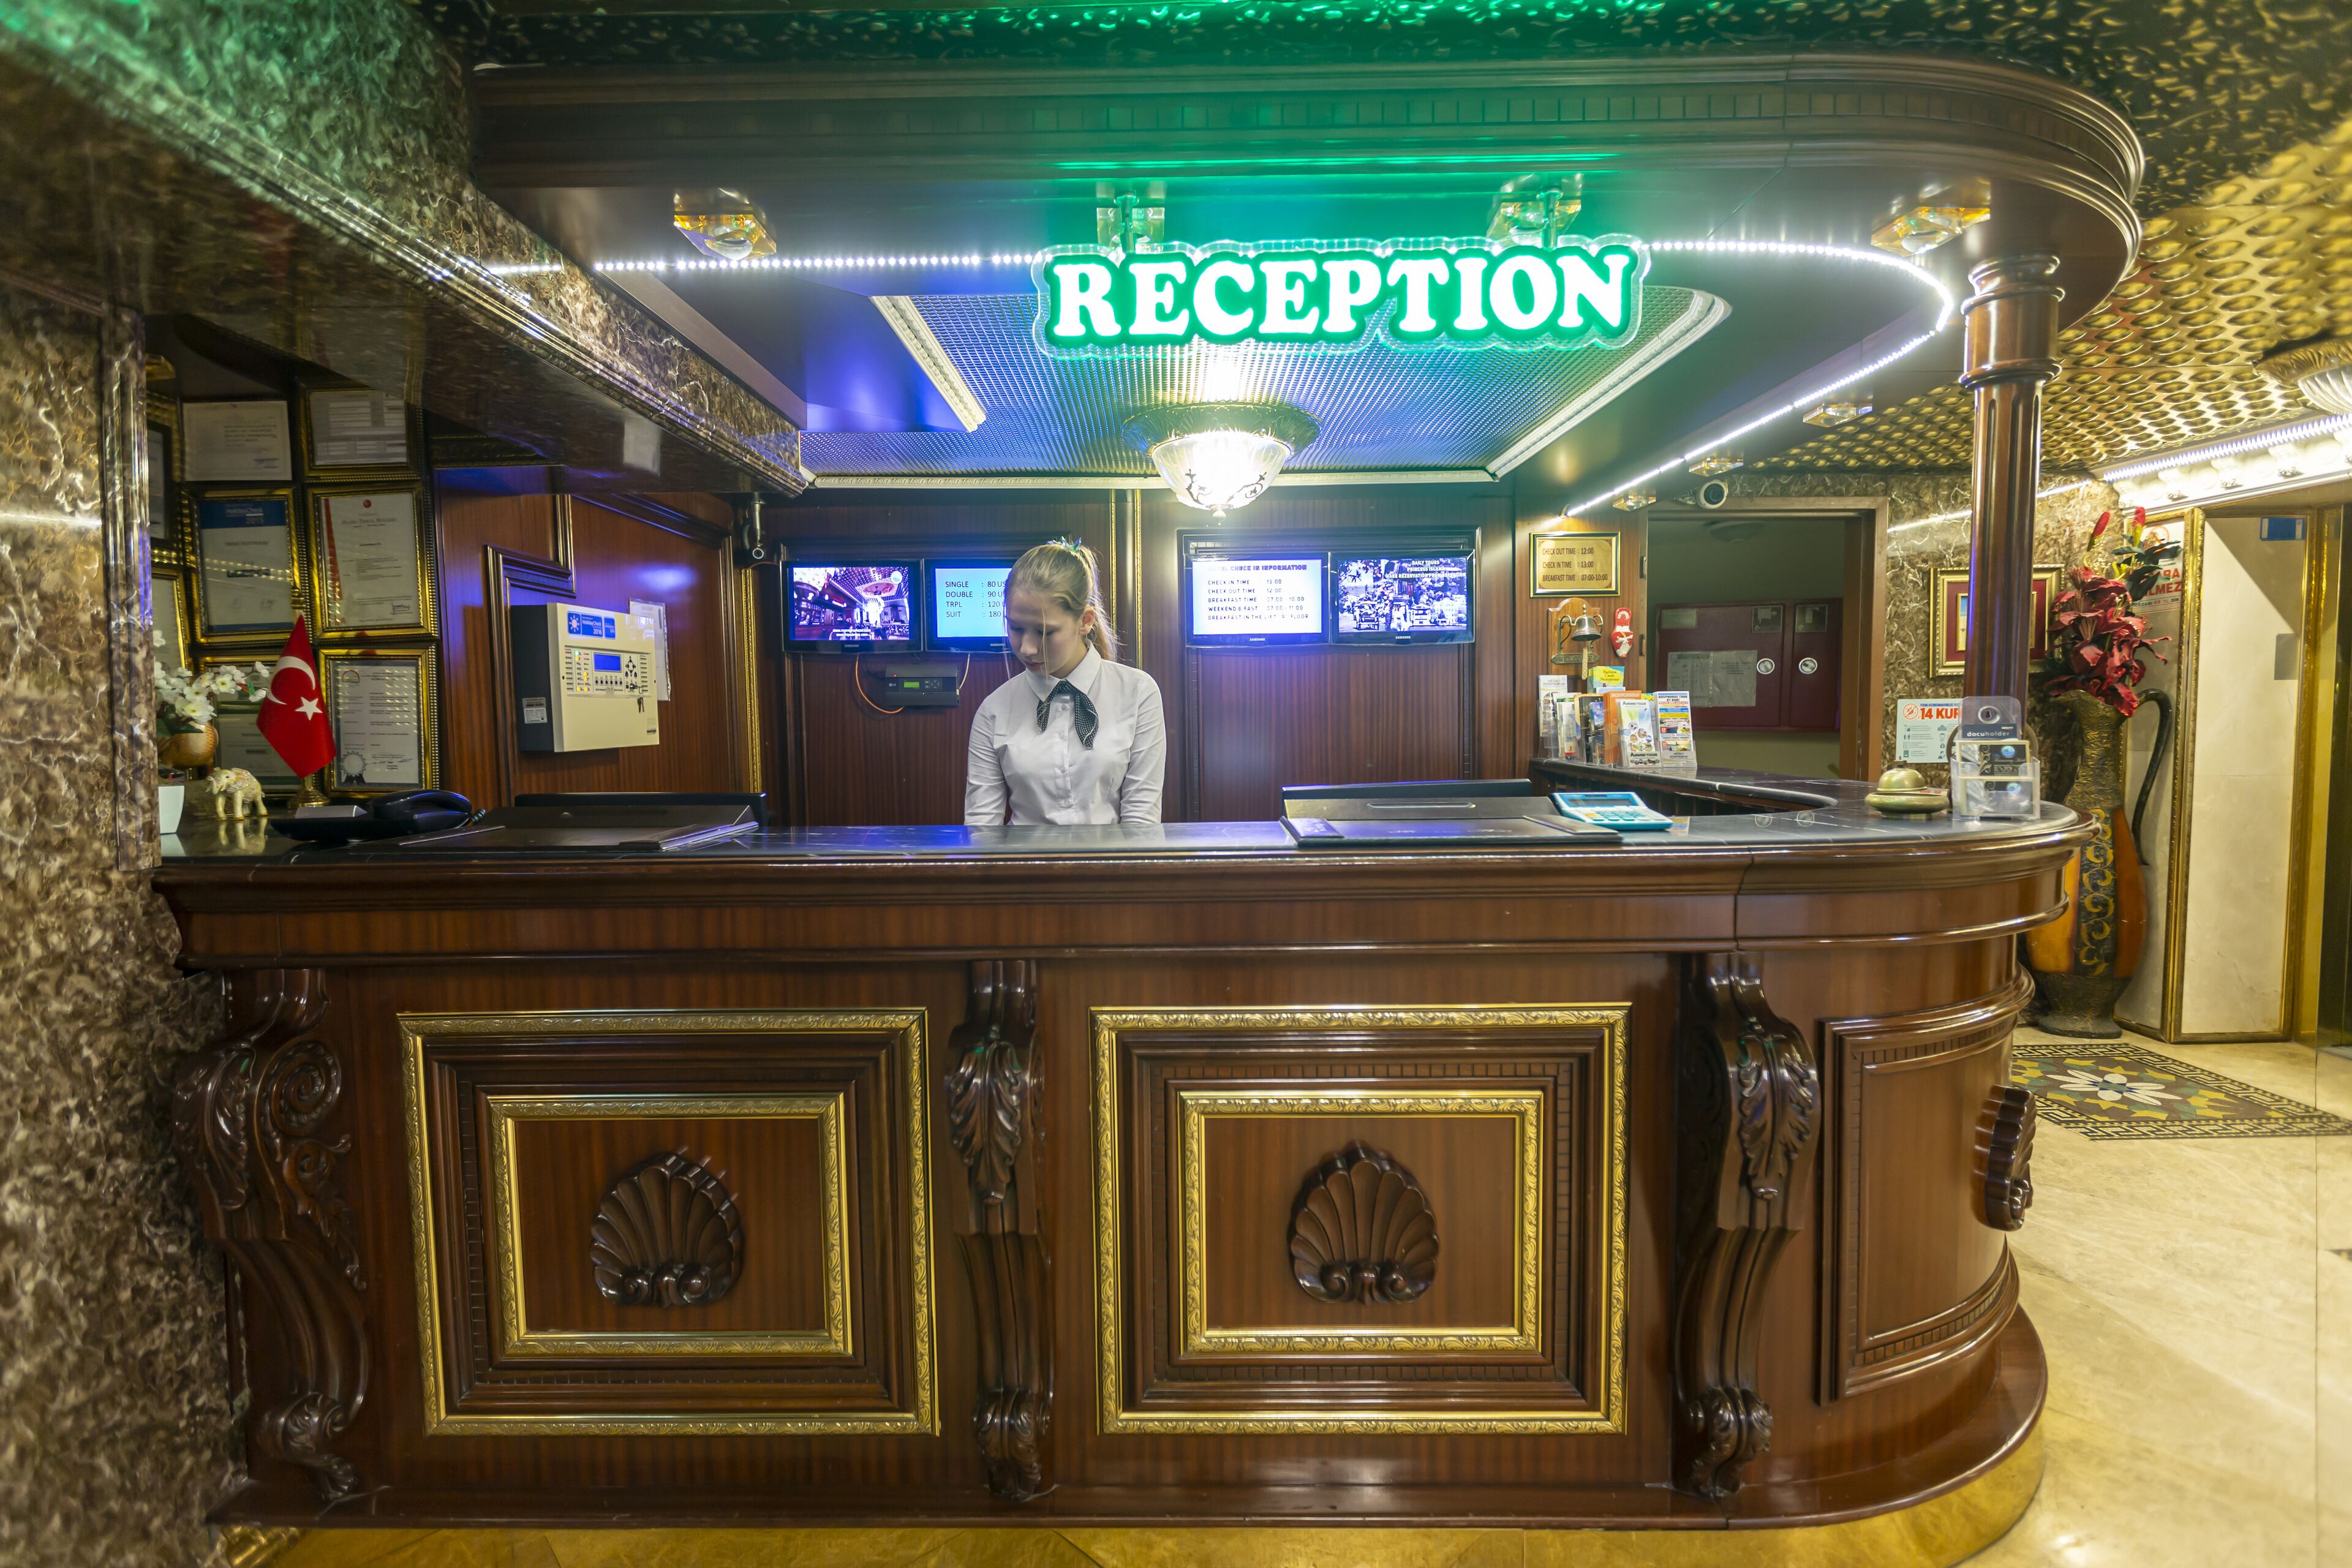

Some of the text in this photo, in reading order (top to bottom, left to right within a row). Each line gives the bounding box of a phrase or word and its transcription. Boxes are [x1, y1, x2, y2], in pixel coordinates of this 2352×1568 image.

[1052, 254, 1632, 338] RECEPTION
[1920, 707, 1960, 720] 14 KUR
